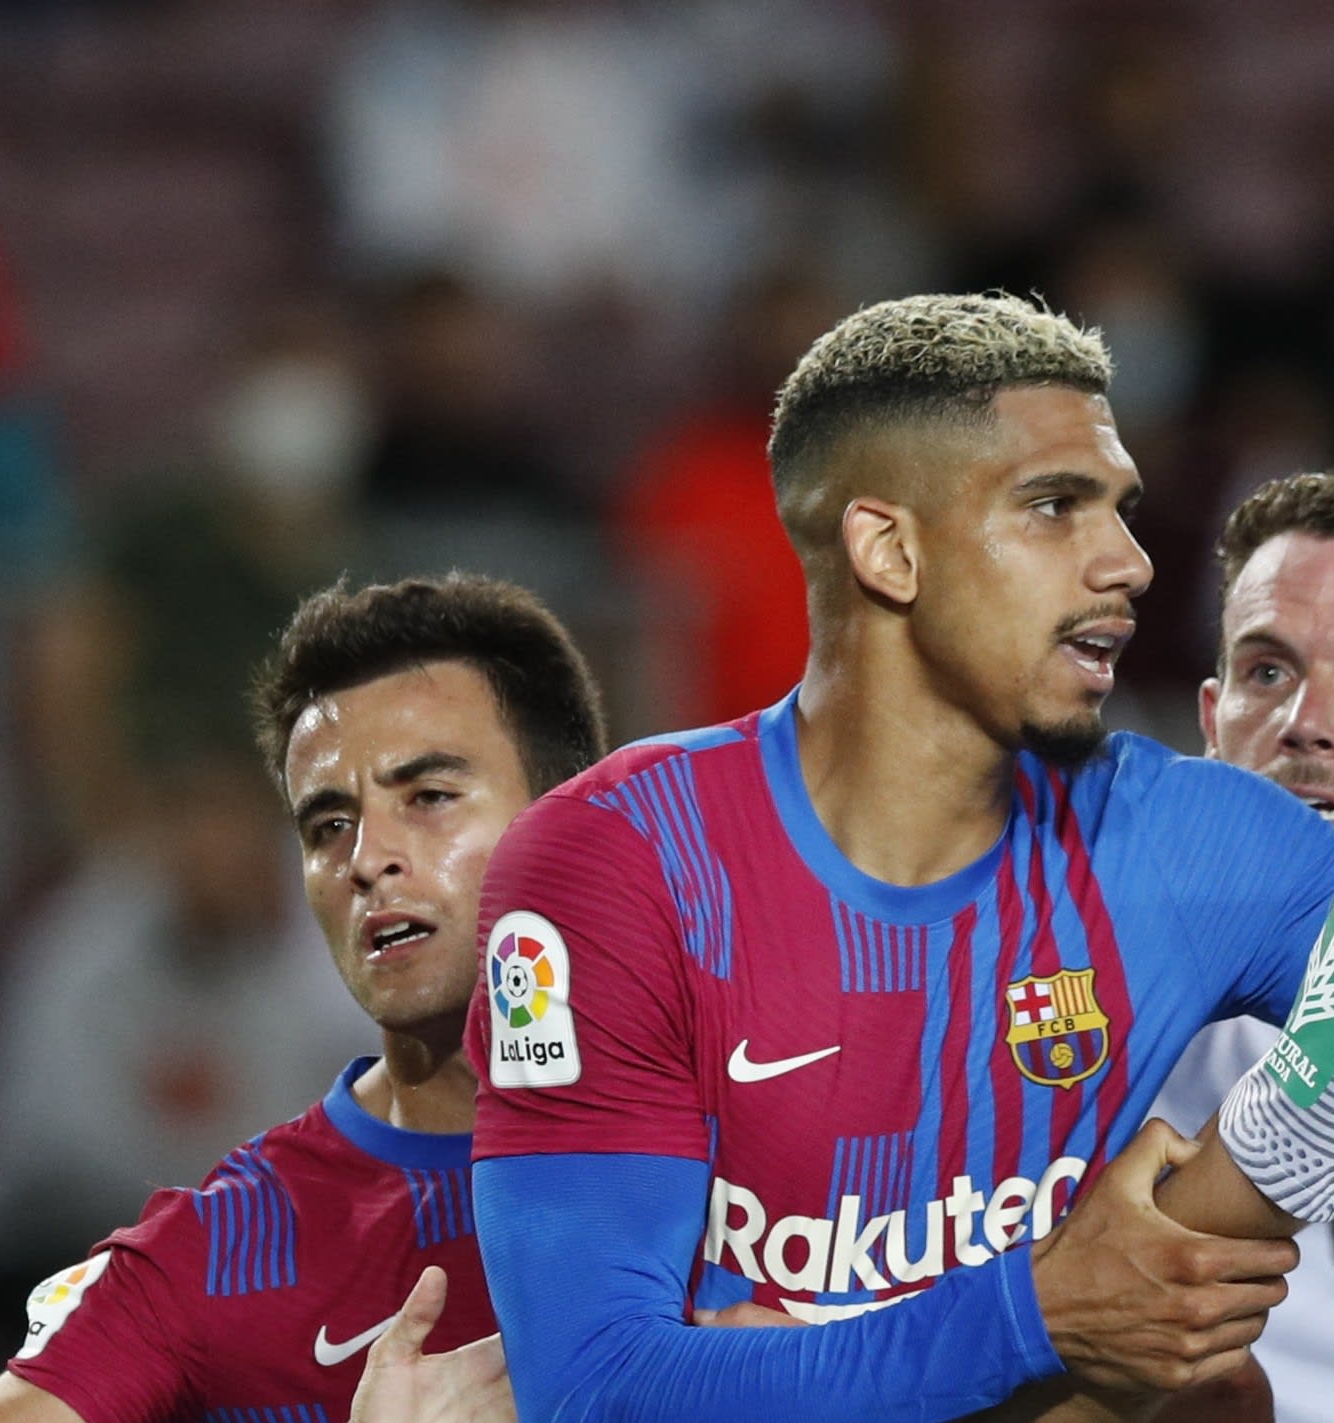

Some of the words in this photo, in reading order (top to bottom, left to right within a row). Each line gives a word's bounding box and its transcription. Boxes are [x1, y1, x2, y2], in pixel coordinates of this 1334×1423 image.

[1037, 1018, 1076, 1036] FCB
[500, 1036, 565, 1066] LaLiga
[703, 1156, 1089, 1294] Rakuten
